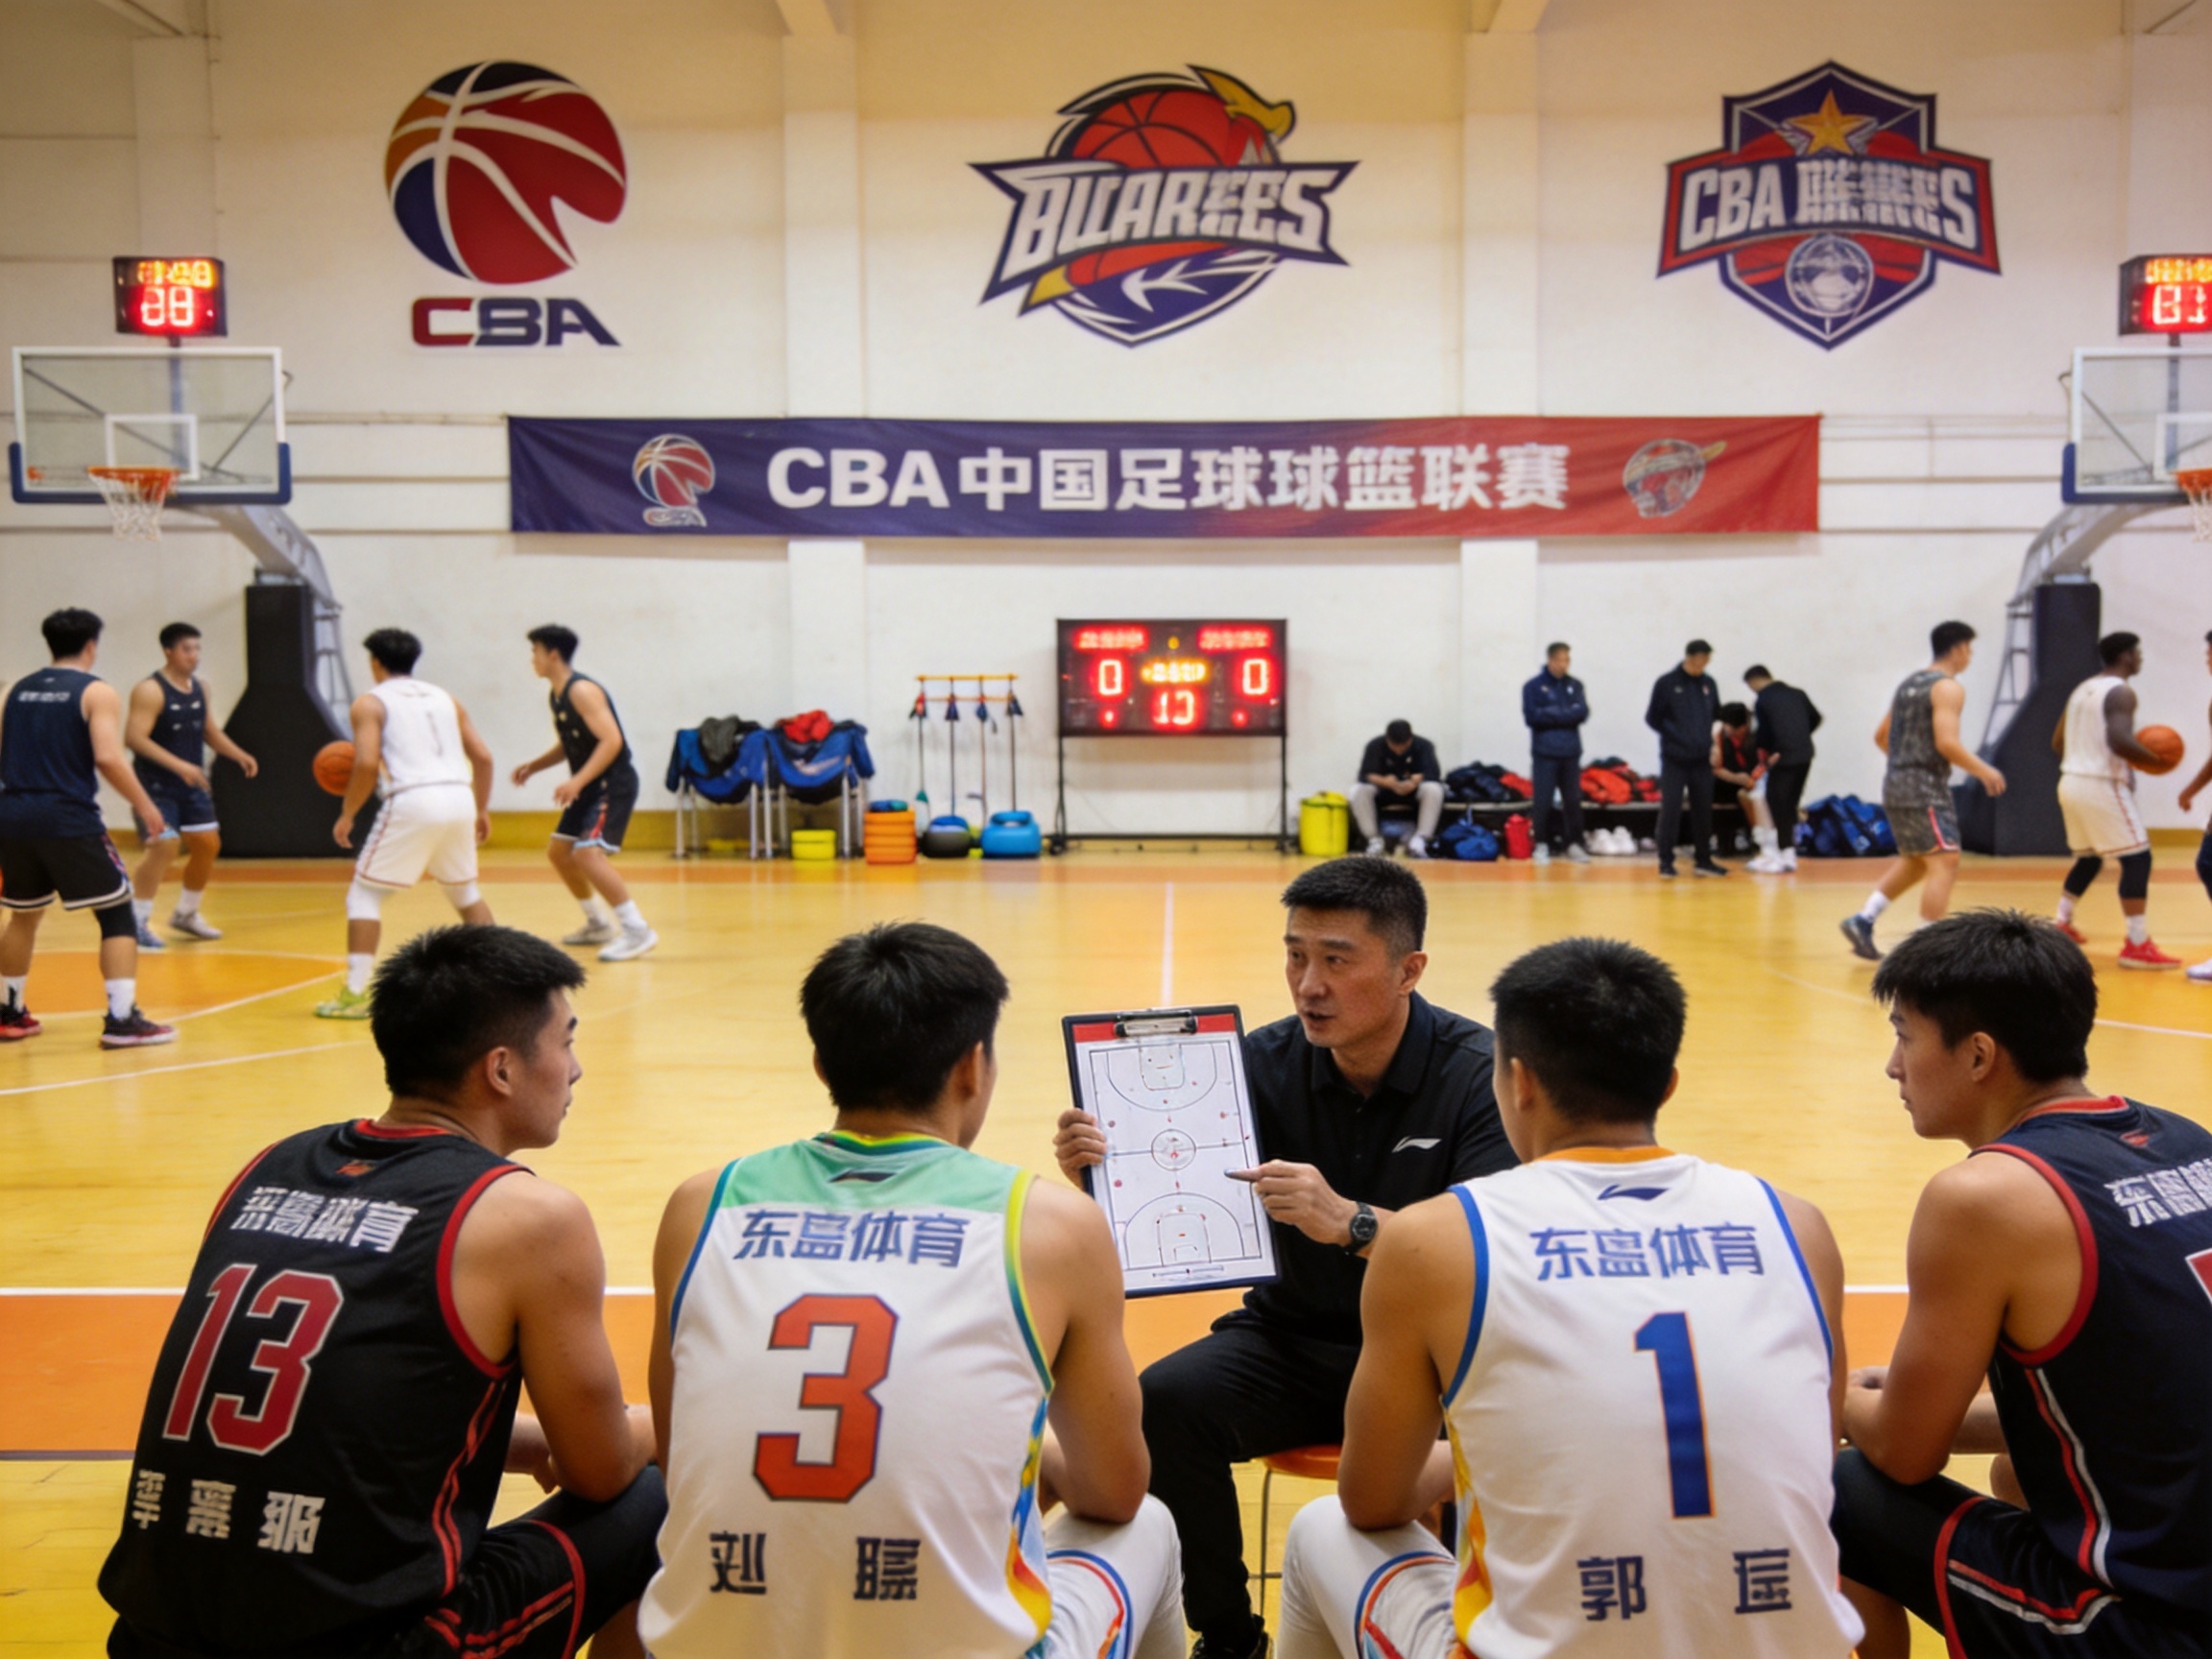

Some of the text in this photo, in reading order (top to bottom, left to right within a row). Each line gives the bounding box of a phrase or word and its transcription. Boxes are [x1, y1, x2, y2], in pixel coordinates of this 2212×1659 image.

[1679, 163, 1787, 252] CBA
[411, 296, 622, 347] CBA
[767, 447, 950, 509] CBA
[162, 1262, 344, 1456] 13
[753, 1293, 900, 1504] 3
[1633, 1311, 1717, 1520] 1
